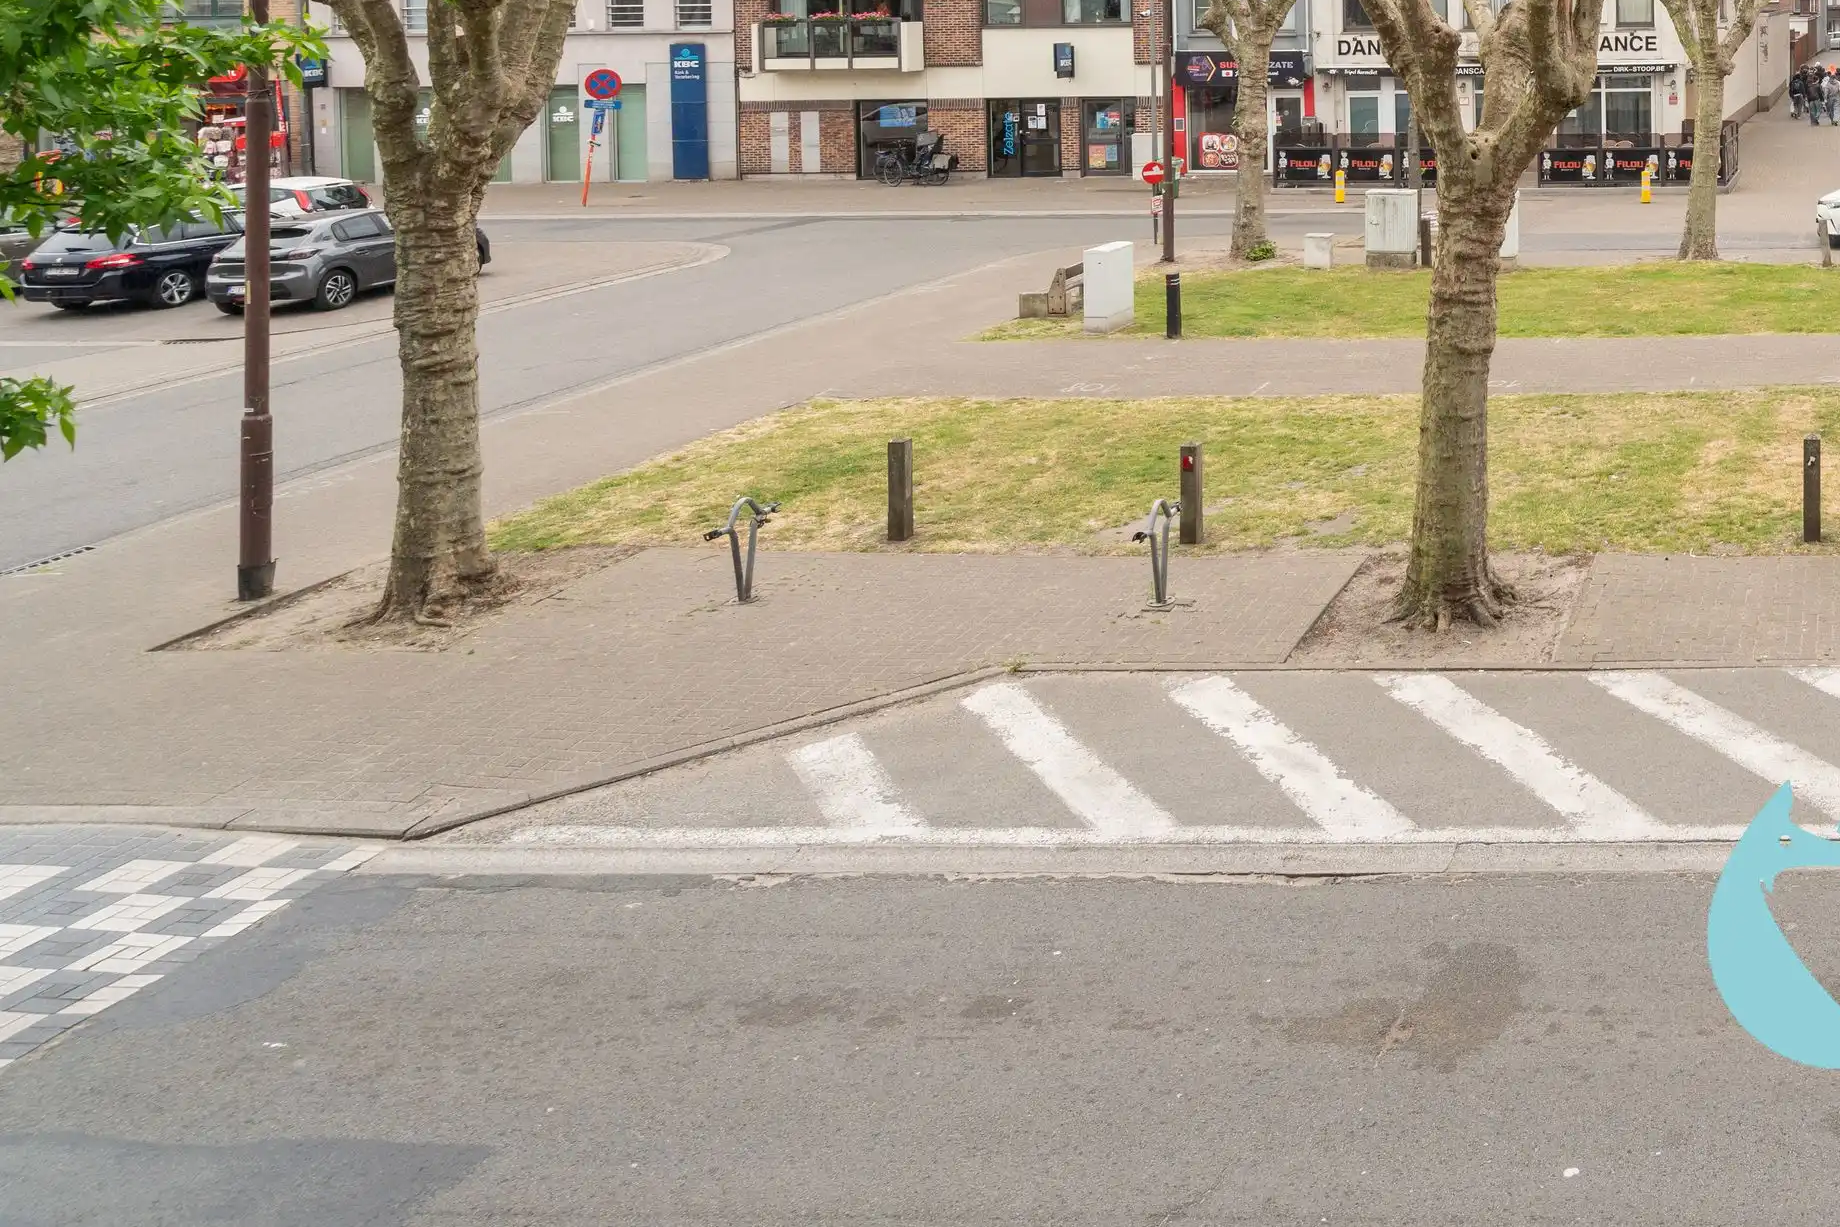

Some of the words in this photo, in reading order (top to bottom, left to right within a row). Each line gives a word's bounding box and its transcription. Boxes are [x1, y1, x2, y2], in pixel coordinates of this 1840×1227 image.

[674, 60, 699, 68] KBC
[1003, 111, 1014, 155] Zelzate
[1289, 159, 1317, 168] FILOU
[1351, 159, 1378, 168] FILOU
[1553, 160, 1581, 169] FILOU
[1616, 160, 1644, 169] FILOU
